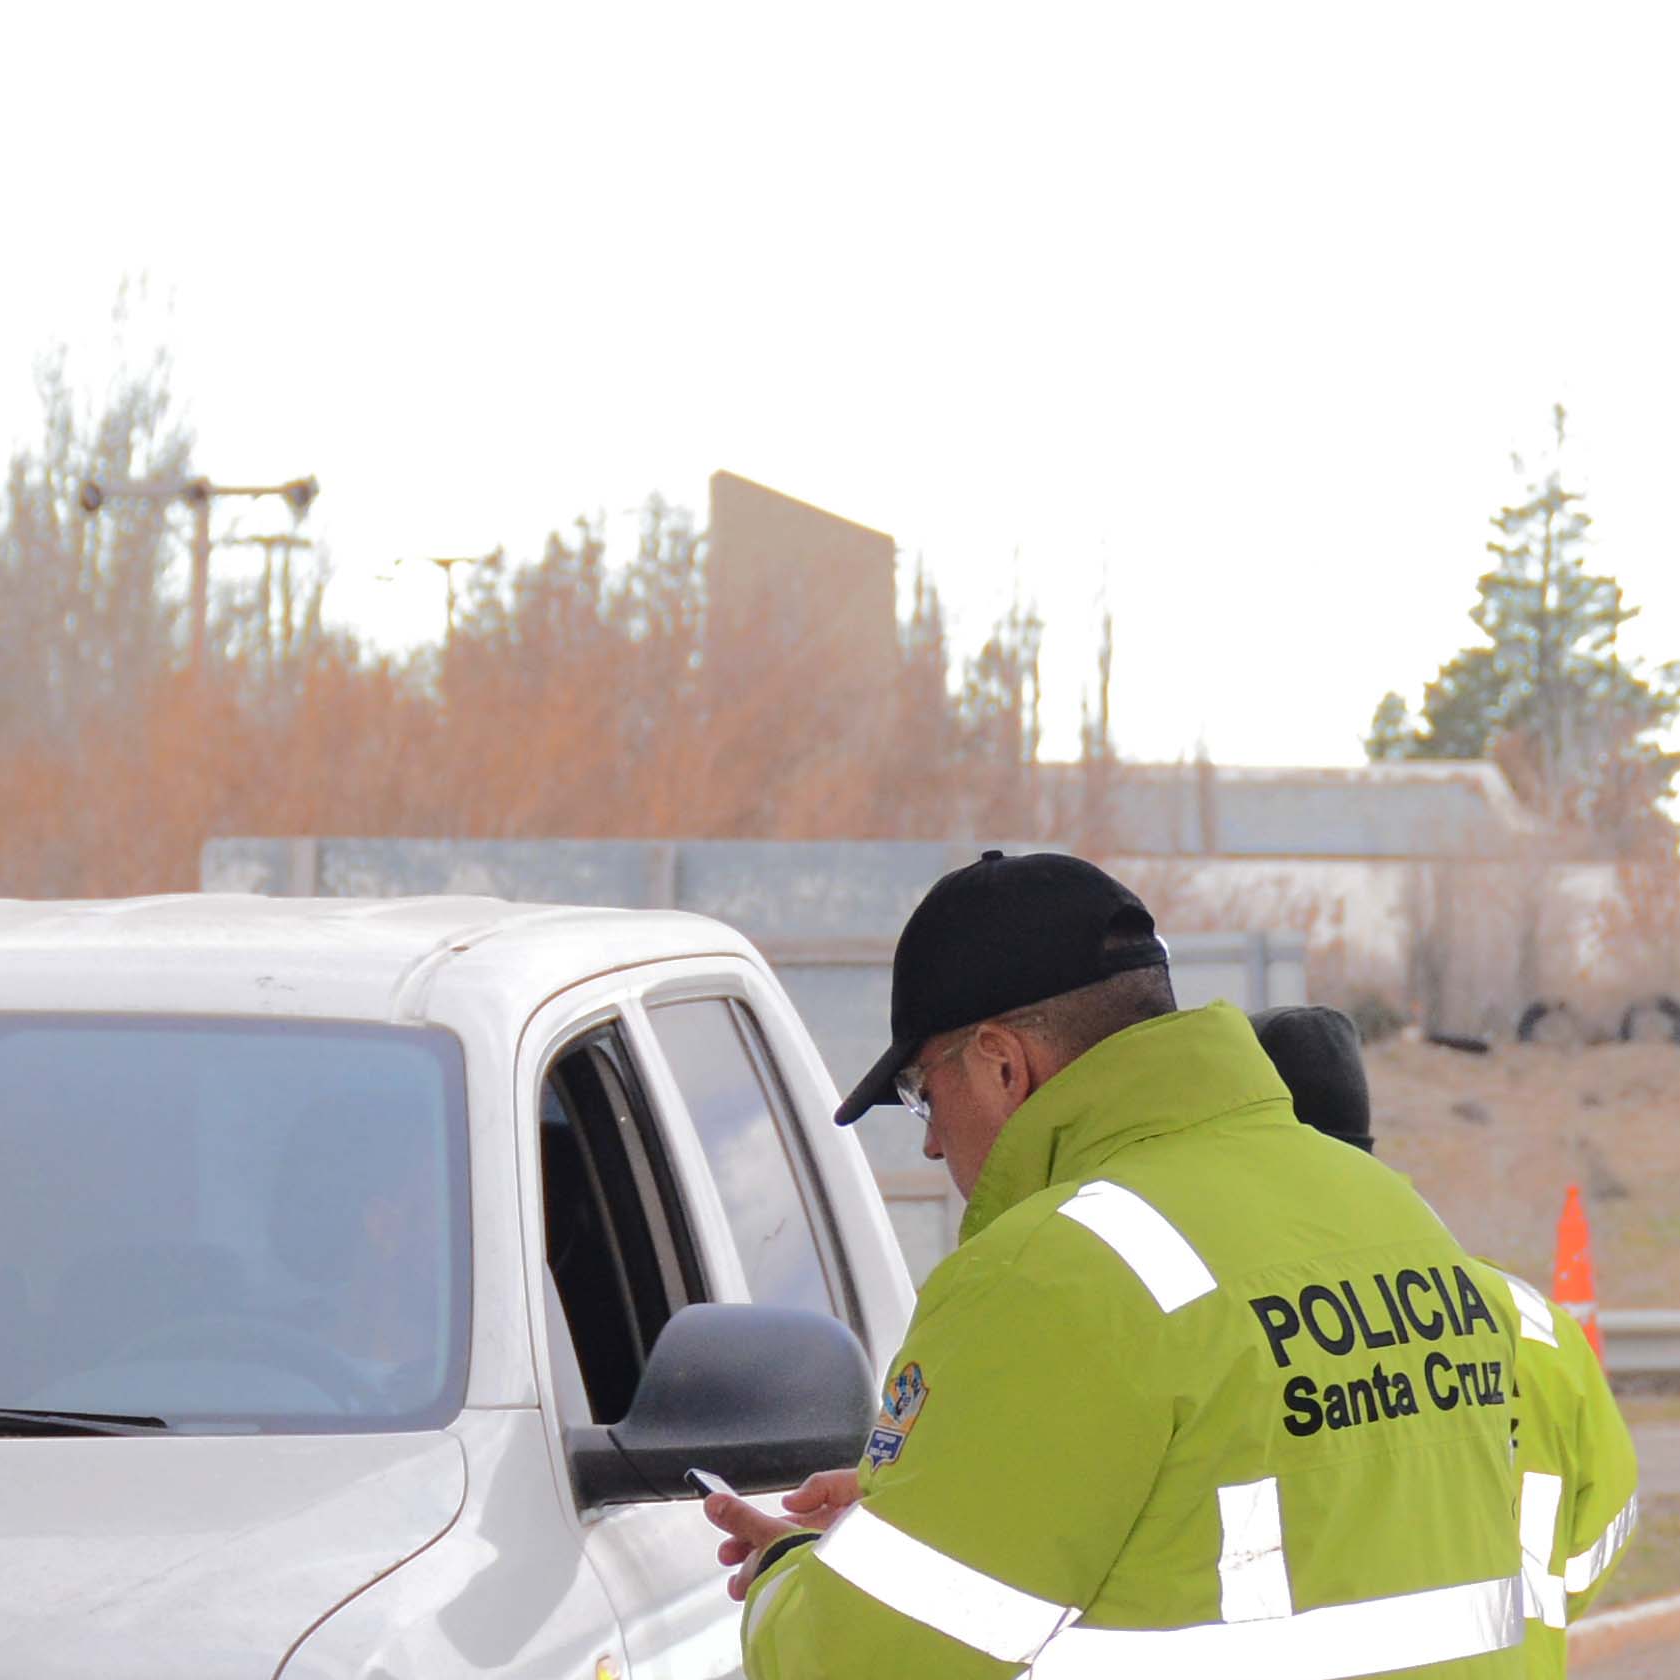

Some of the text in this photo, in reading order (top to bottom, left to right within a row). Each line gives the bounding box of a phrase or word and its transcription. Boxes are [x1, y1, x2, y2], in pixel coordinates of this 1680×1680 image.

[1249, 1265, 1499, 1368] POLICIA
[1283, 1351, 1505, 1437] Santa Cruz
